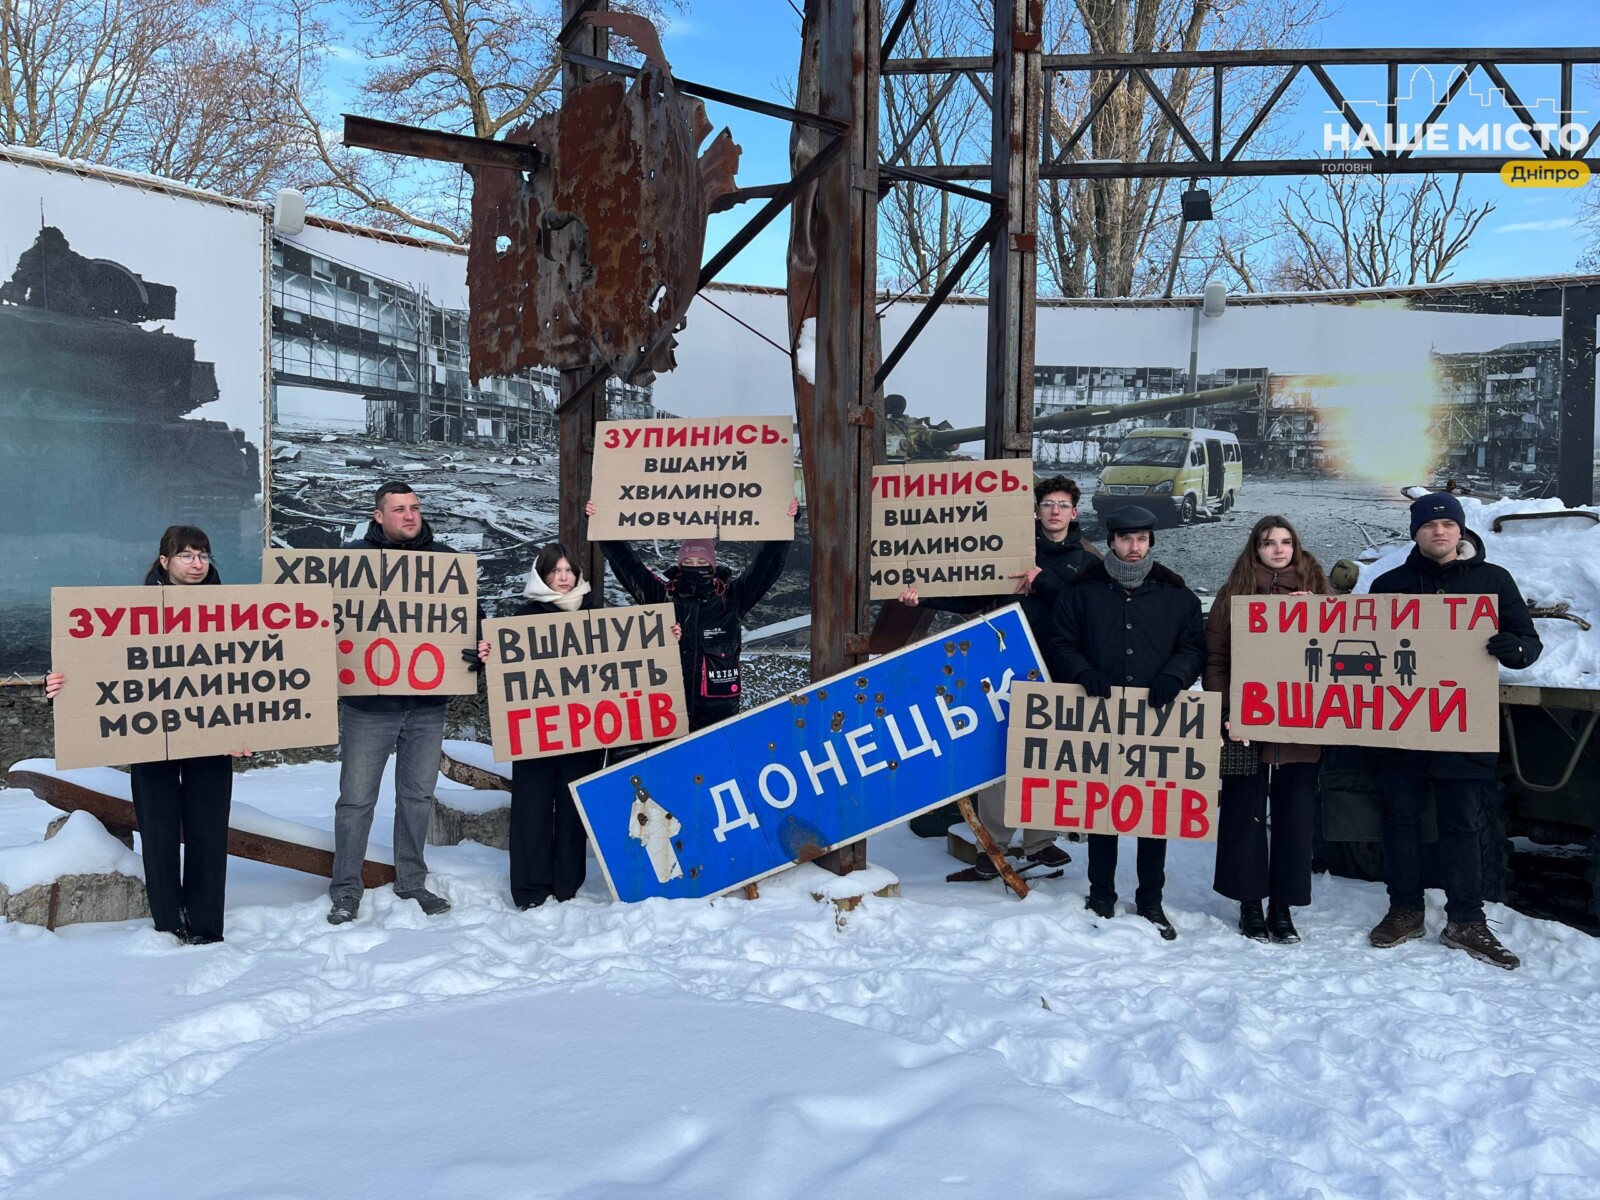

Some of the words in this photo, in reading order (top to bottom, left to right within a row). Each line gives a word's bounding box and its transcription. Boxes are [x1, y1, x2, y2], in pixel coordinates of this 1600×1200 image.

[603, 424, 789, 449] ЗУПИНИСЬ.
[644, 450, 748, 473] ВШАНУЙ
[618, 482, 762, 500] ХВИЛИНОЮ
[618, 510, 760, 527] МОВЧАННЯ.
[884, 501, 988, 526] ВШАНУЙ
[273, 554, 469, 596] ХВИЛИНА
[68, 602, 330, 638] ЗУПИНИСЬ.
[1248, 597, 1420, 633] ВИЙДИ
[1443, 596, 1499, 630] ТА
[126, 633, 284, 670] ВШАНУЙ
[498, 610, 666, 664] ВШАНУЙ
[95, 668, 311, 706] ХВИЛИНОЮ
[503, 658, 668, 702] ПАМ'ЯТЬ
[99, 698, 312, 738] МОВЧАННЯ.
[506, 690, 678, 756] ГЕРОЇВ
[1025, 693, 1206, 740] ВШАНУЙ
[1241, 680, 1467, 732] ВШАНУЙ
[709, 667, 1015, 843] ДОНЕЦЬК
[1023, 737, 1207, 780] ПАМ'ЯТЬ
[1020, 777, 1210, 839] ГЕРОЇВ
